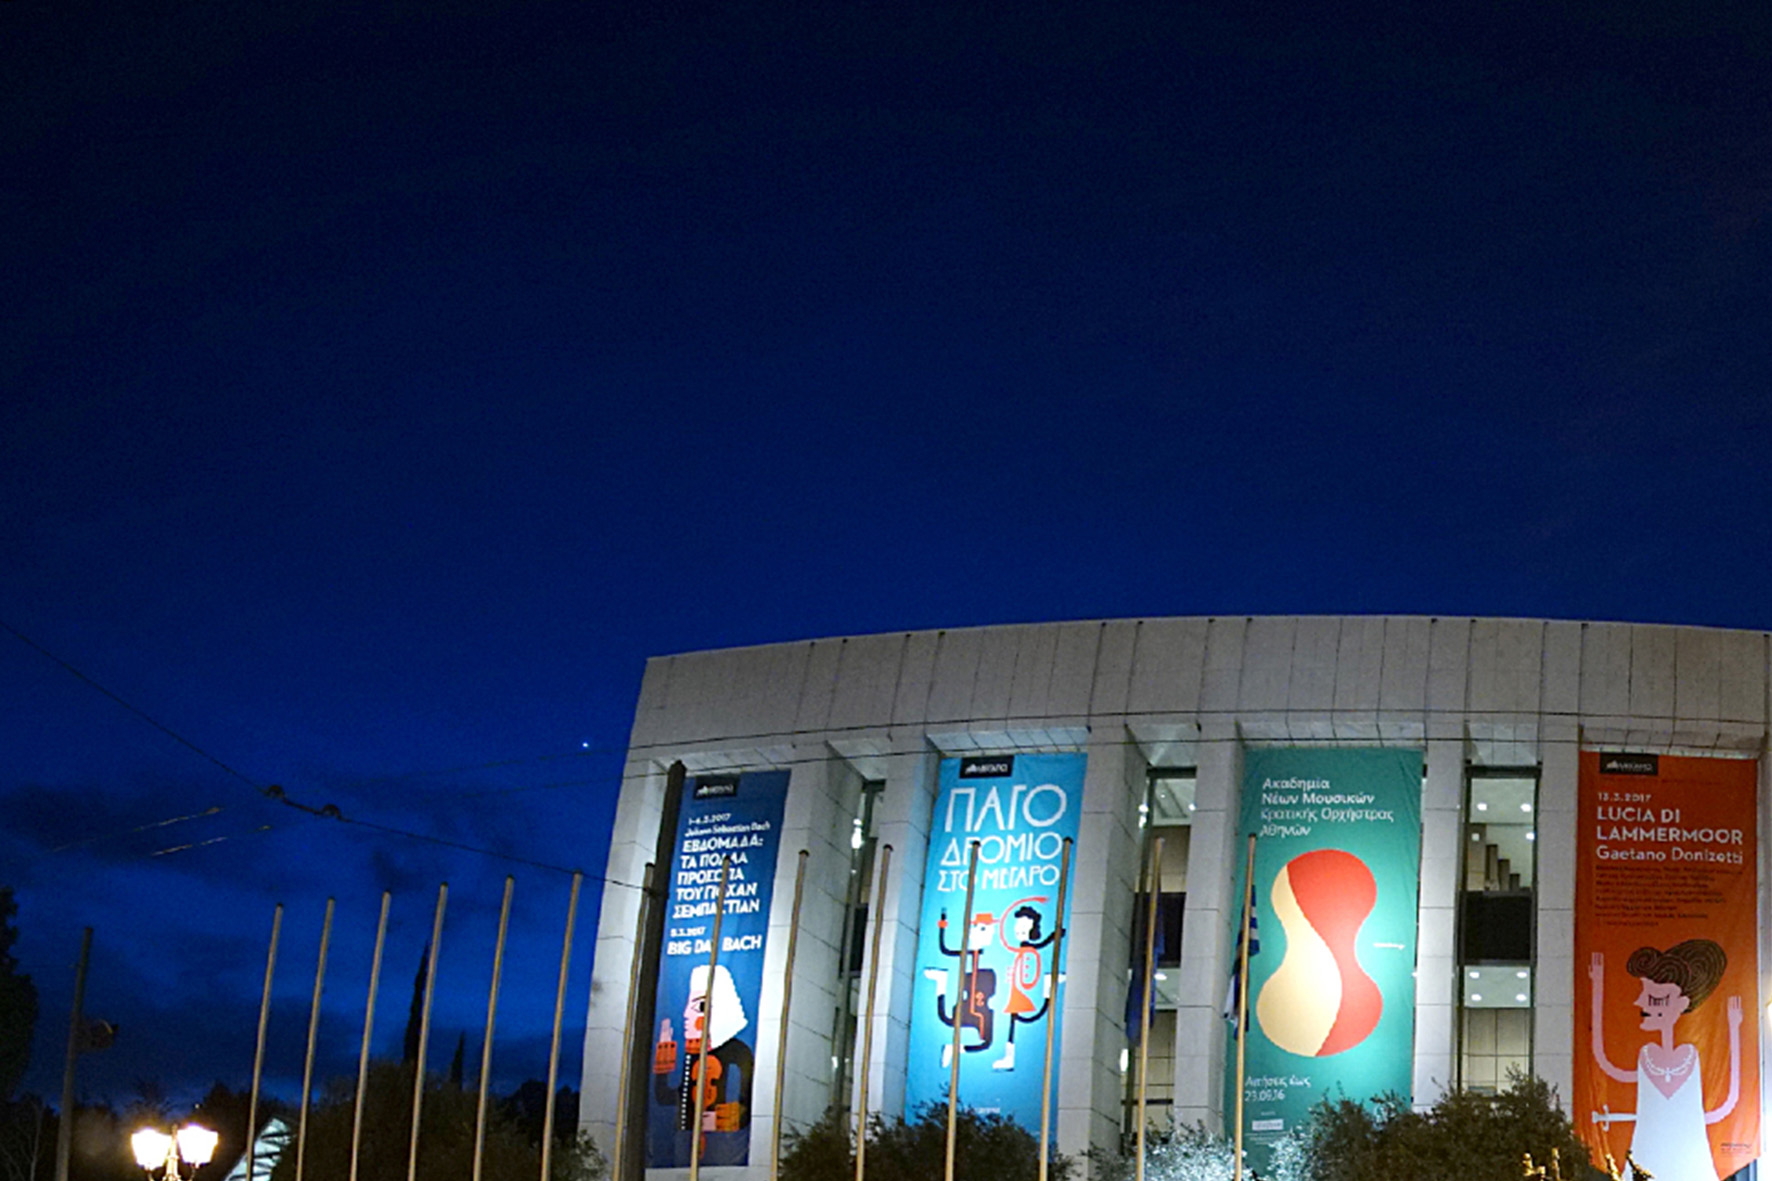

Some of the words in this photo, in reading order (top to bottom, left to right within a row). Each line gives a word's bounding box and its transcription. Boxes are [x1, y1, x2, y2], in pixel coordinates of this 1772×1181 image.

[1262, 777, 1331, 791] Ακαδημία
[1262, 792, 1299, 805] Νέων
[1302, 791, 1375, 805] Μουσικών
[944, 783, 1067, 833] ΠΑΓΟ
[1320, 806, 1394, 823] Ορχήστρας
[1596, 806, 1656, 823] LUCIA
[1660, 808, 1680, 824] DI
[682, 833, 764, 852] ΕΒΔΟΜΑΔΑ:
[1596, 825, 1743, 845] LAMMERMOOR
[940, 832, 1063, 866] ΔΡΟΜΙΟ
[1596, 845, 1667, 862] Gaetano
[1671, 846, 1744, 865] Donizetti
[680, 854, 698, 870] ΤΑ
[937, 870, 978, 892] ΣΤΟ
[981, 864, 1060, 890] ΜΕΓΑΡΟ
[676, 886, 704, 902] ΤΟΥ
[666, 940, 693, 956] BIG
[693, 938, 713, 954] DA
[721, 934, 763, 952] BACH
